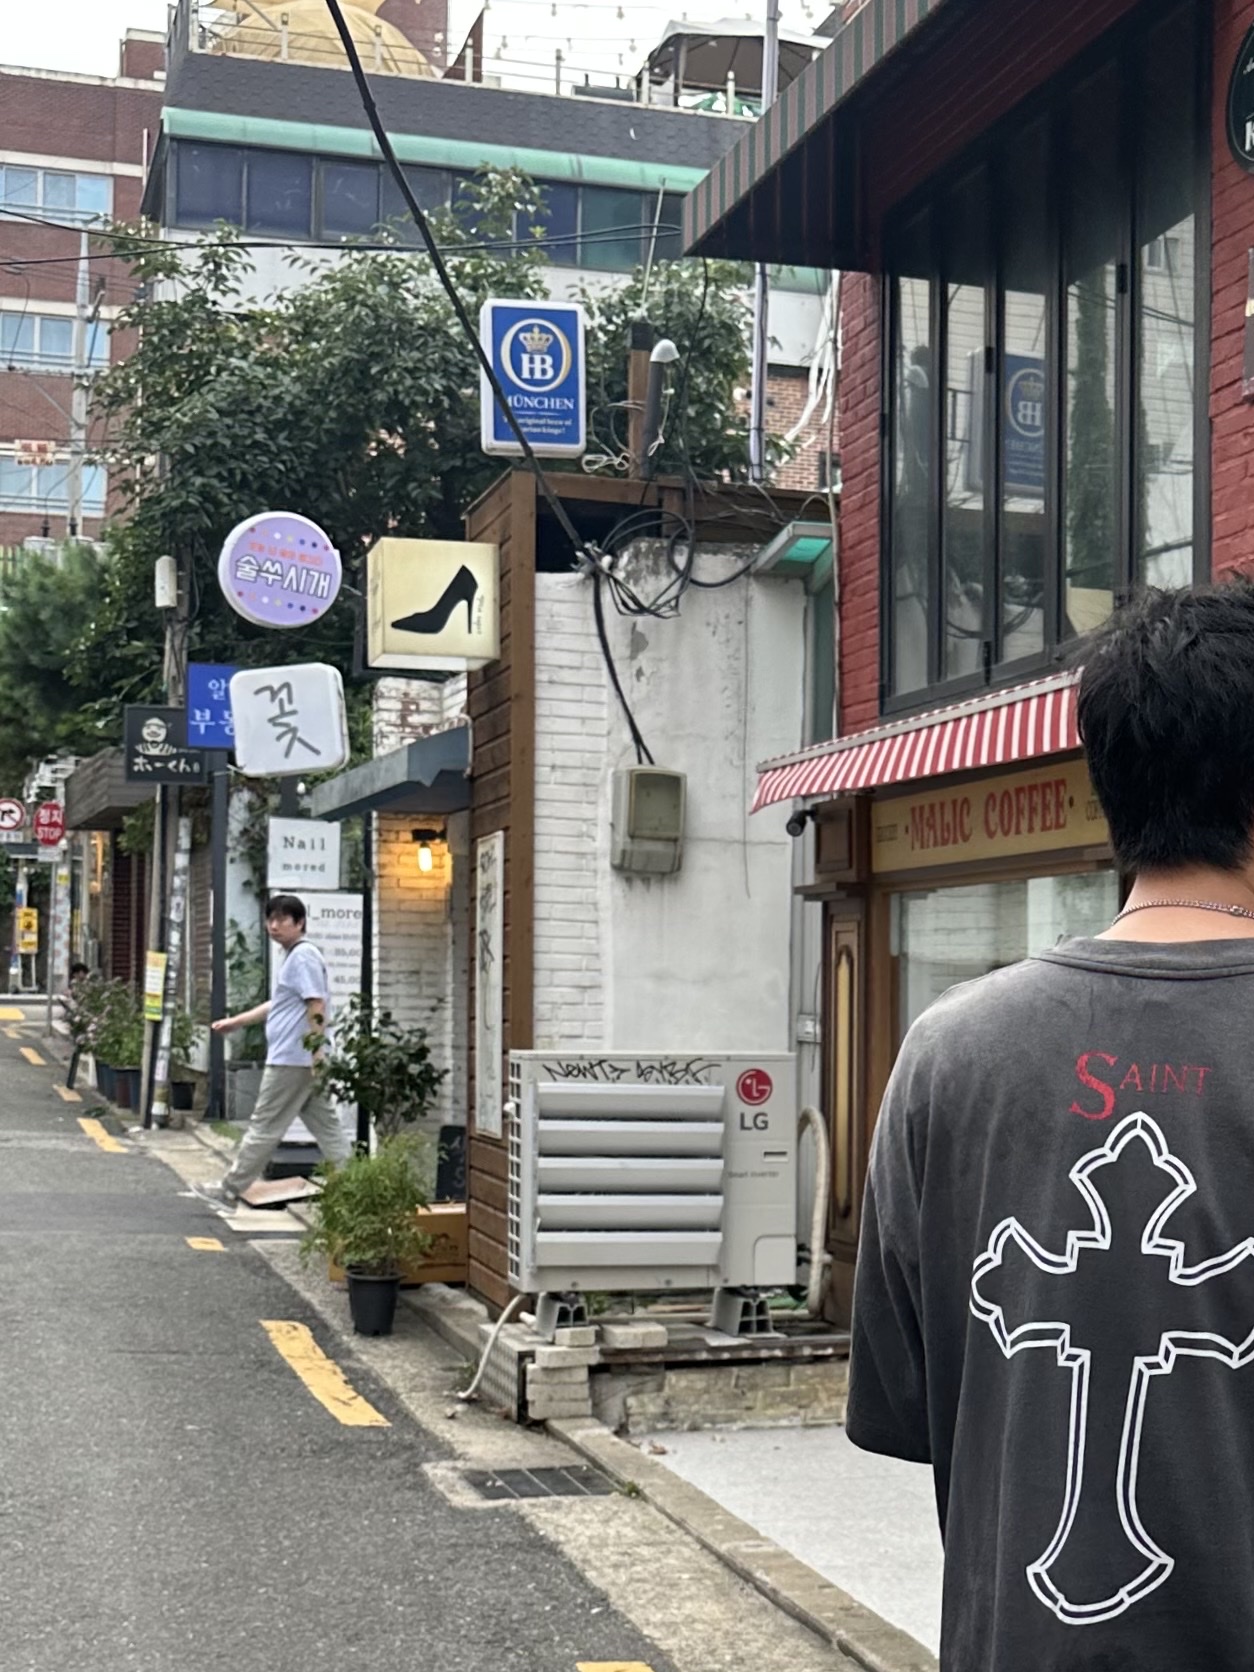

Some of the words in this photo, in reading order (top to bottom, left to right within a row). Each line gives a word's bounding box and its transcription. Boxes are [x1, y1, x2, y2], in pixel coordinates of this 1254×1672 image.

[520, 353, 555, 380] HB
[253, 682, 322, 758] 꽃
[910, 797, 973, 851] MALIC
[984, 778, 1068, 840] COFFEE
[283, 836, 326, 850] Nail
[740, 1112, 769, 1131] LG
